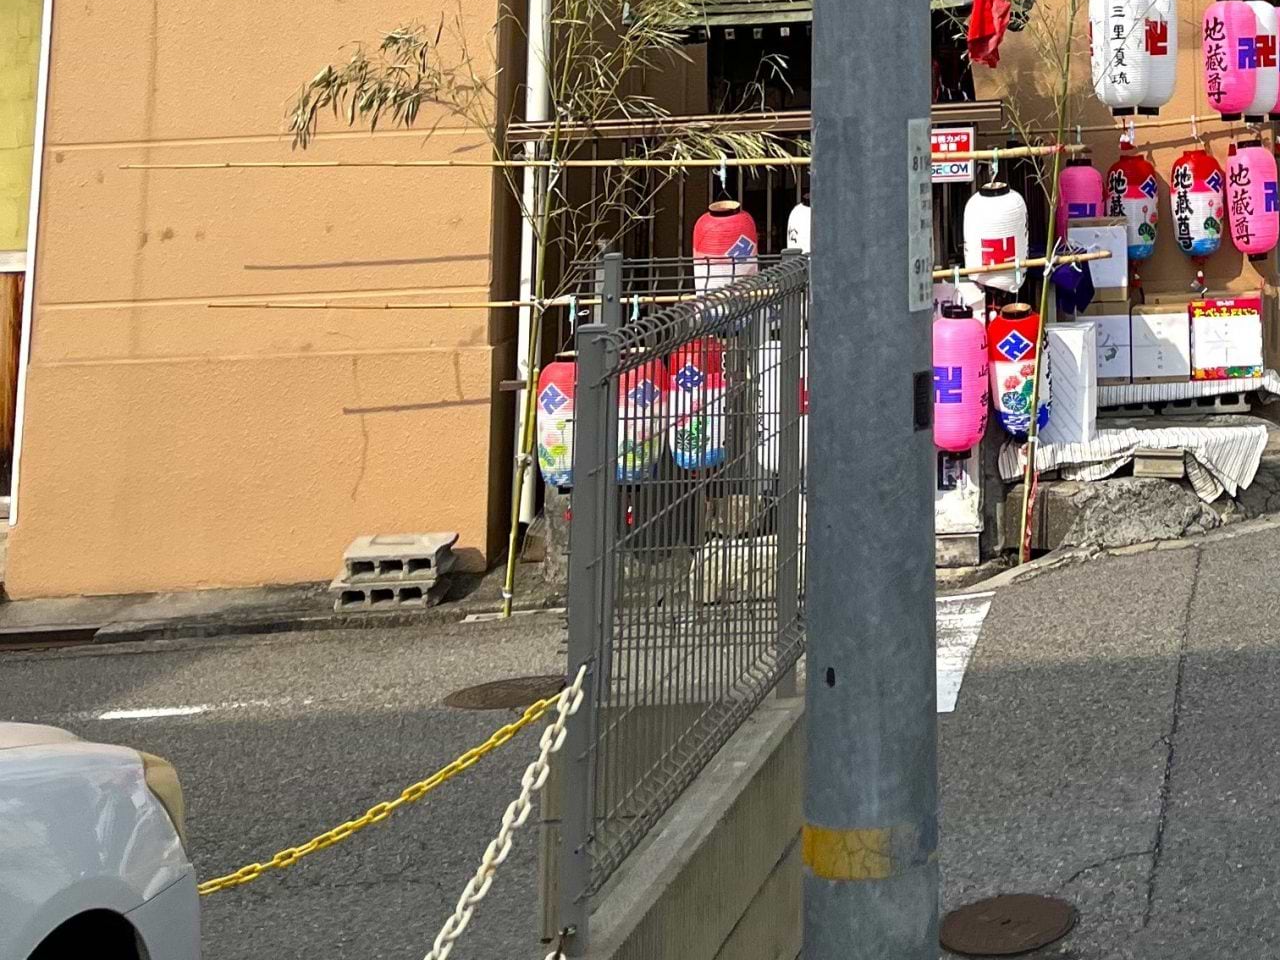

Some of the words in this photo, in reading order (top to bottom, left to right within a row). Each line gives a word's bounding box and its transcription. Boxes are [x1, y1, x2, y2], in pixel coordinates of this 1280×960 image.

[1204, 16, 1228, 104] 地蔵尊
[1173, 165, 1195, 250] 地蔵尊
[1229, 163, 1256, 245] 地蔵尊
